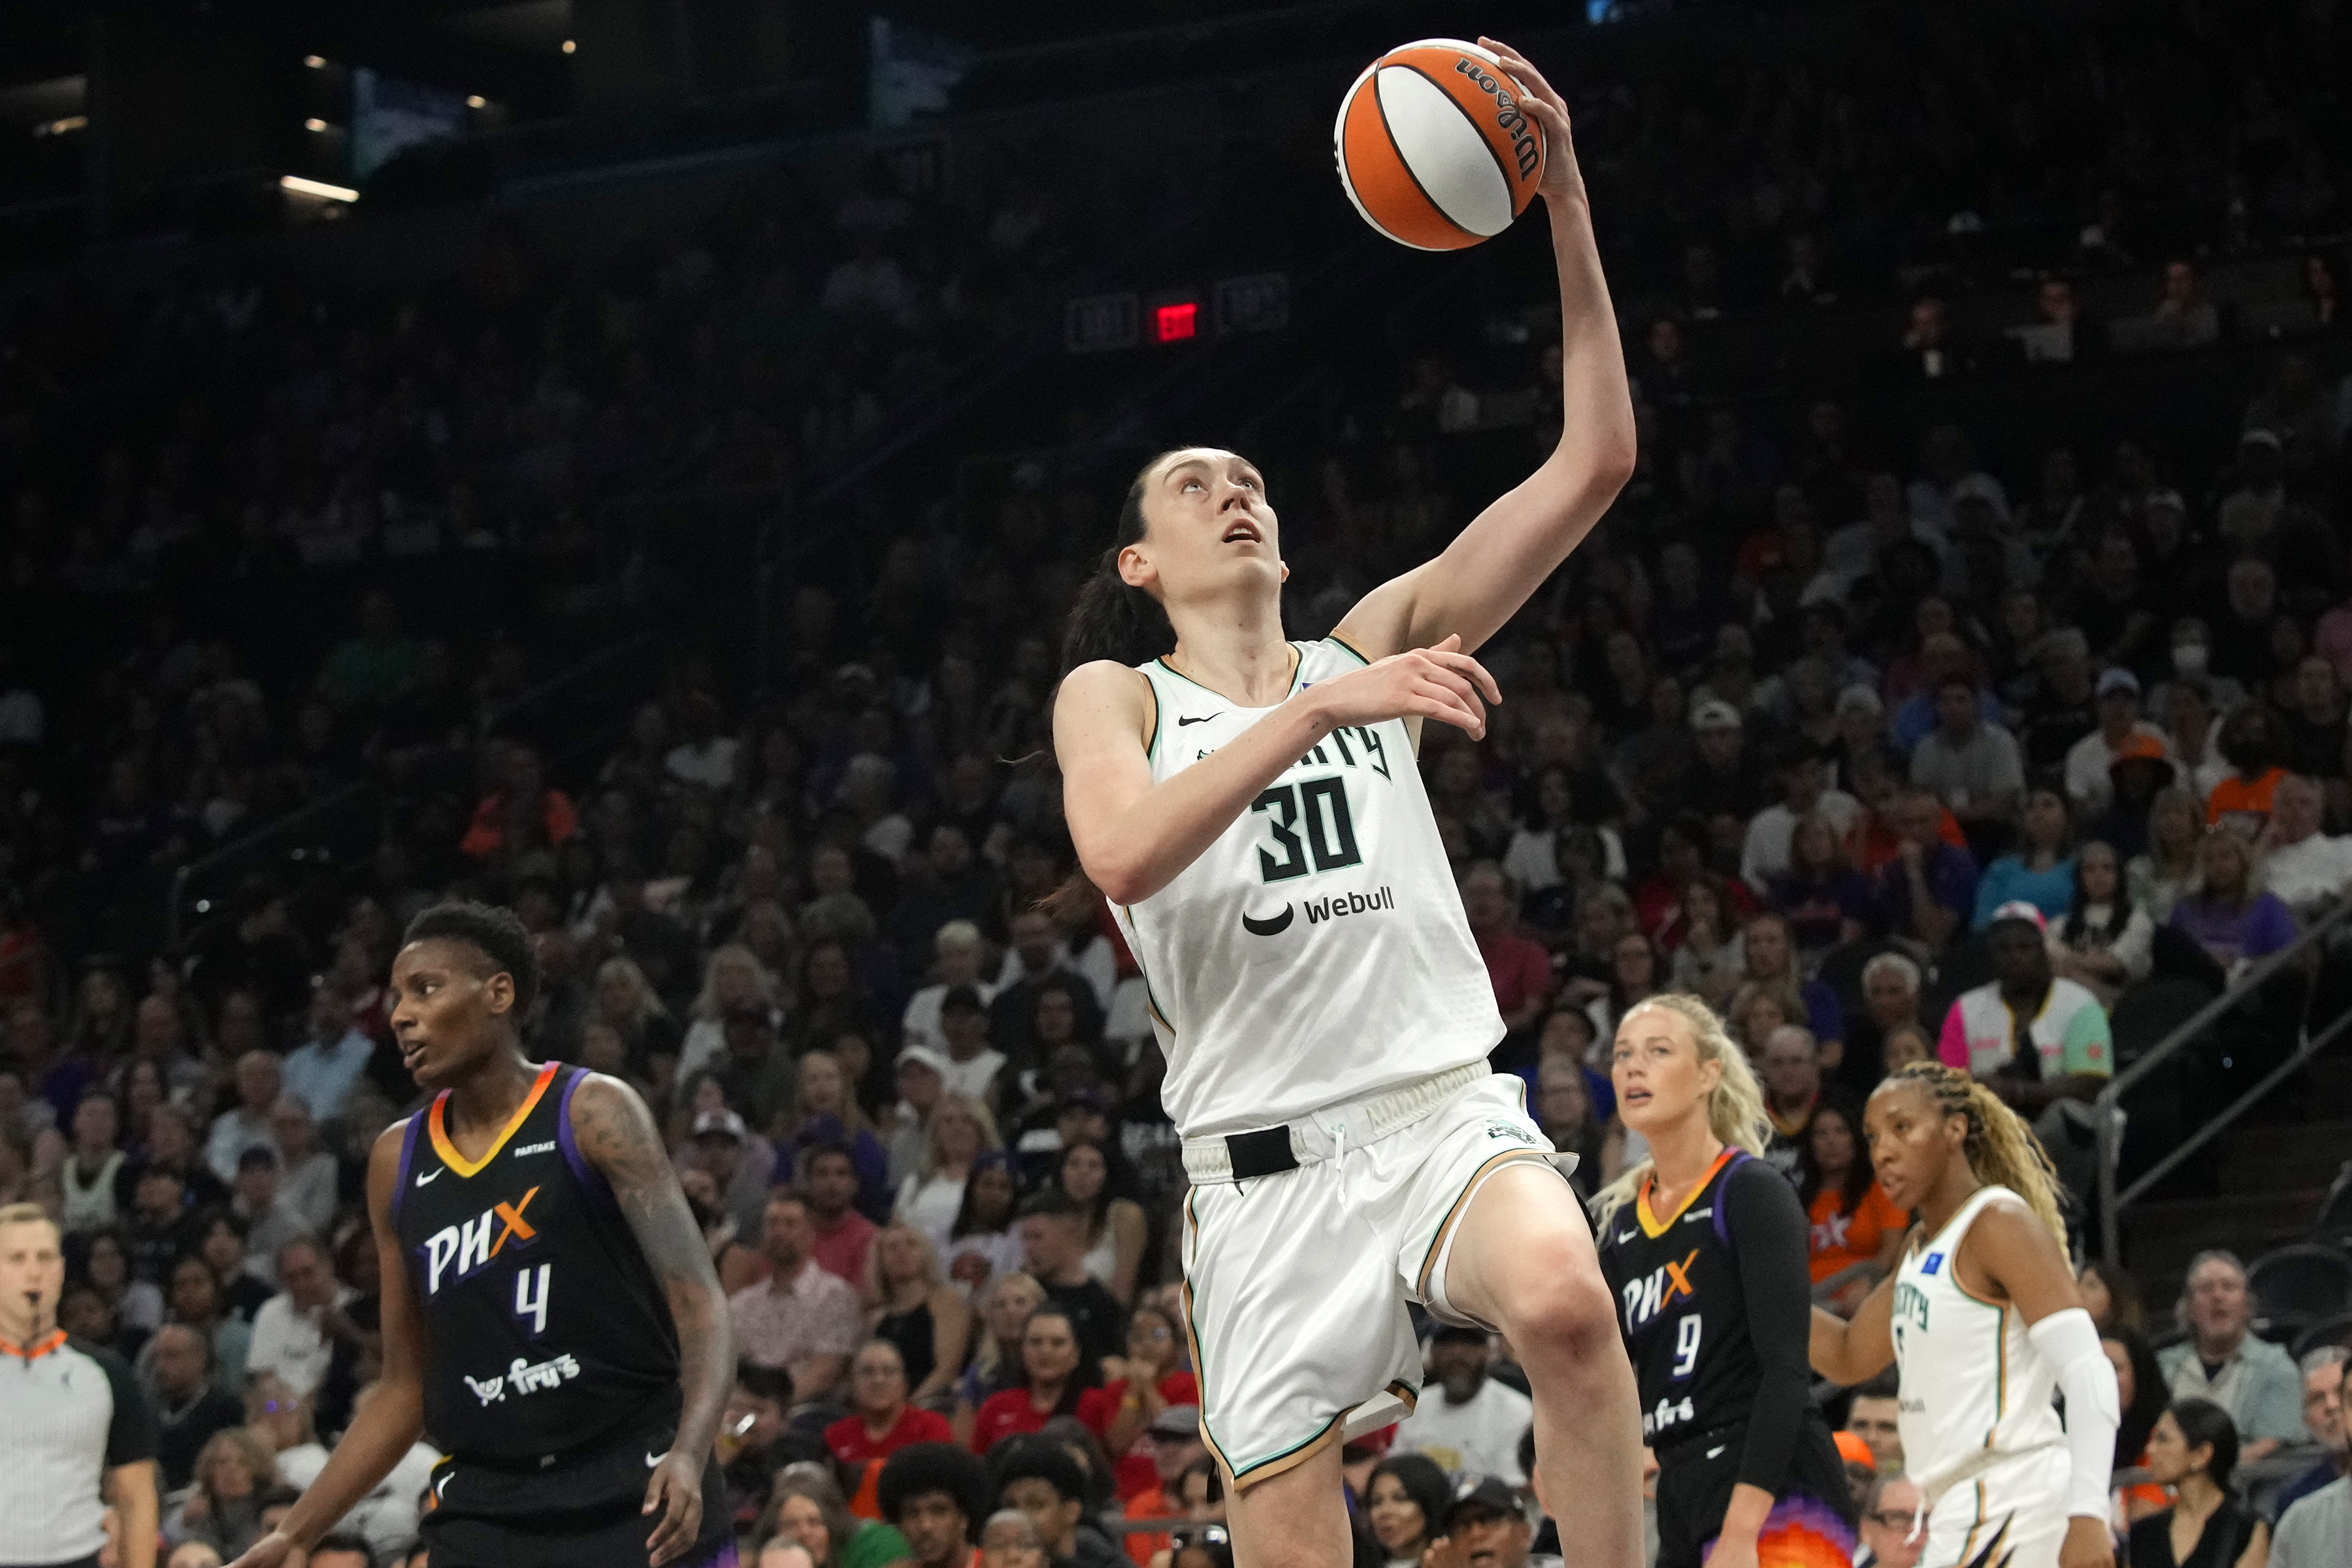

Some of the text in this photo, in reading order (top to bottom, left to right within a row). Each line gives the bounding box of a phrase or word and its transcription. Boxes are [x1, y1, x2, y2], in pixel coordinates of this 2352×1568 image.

[1455, 57, 1539, 183] Wilson
[1250, 775, 1364, 885] 30
[1304, 886, 1395, 924] Webull
[514, 1141, 556, 1158] PARTAKE
[423, 1186, 540, 1295] PHX
[516, 1263, 551, 1334] 4
[1622, 1248, 1699, 1335] PHX
[1673, 1313, 1702, 1377] 9
